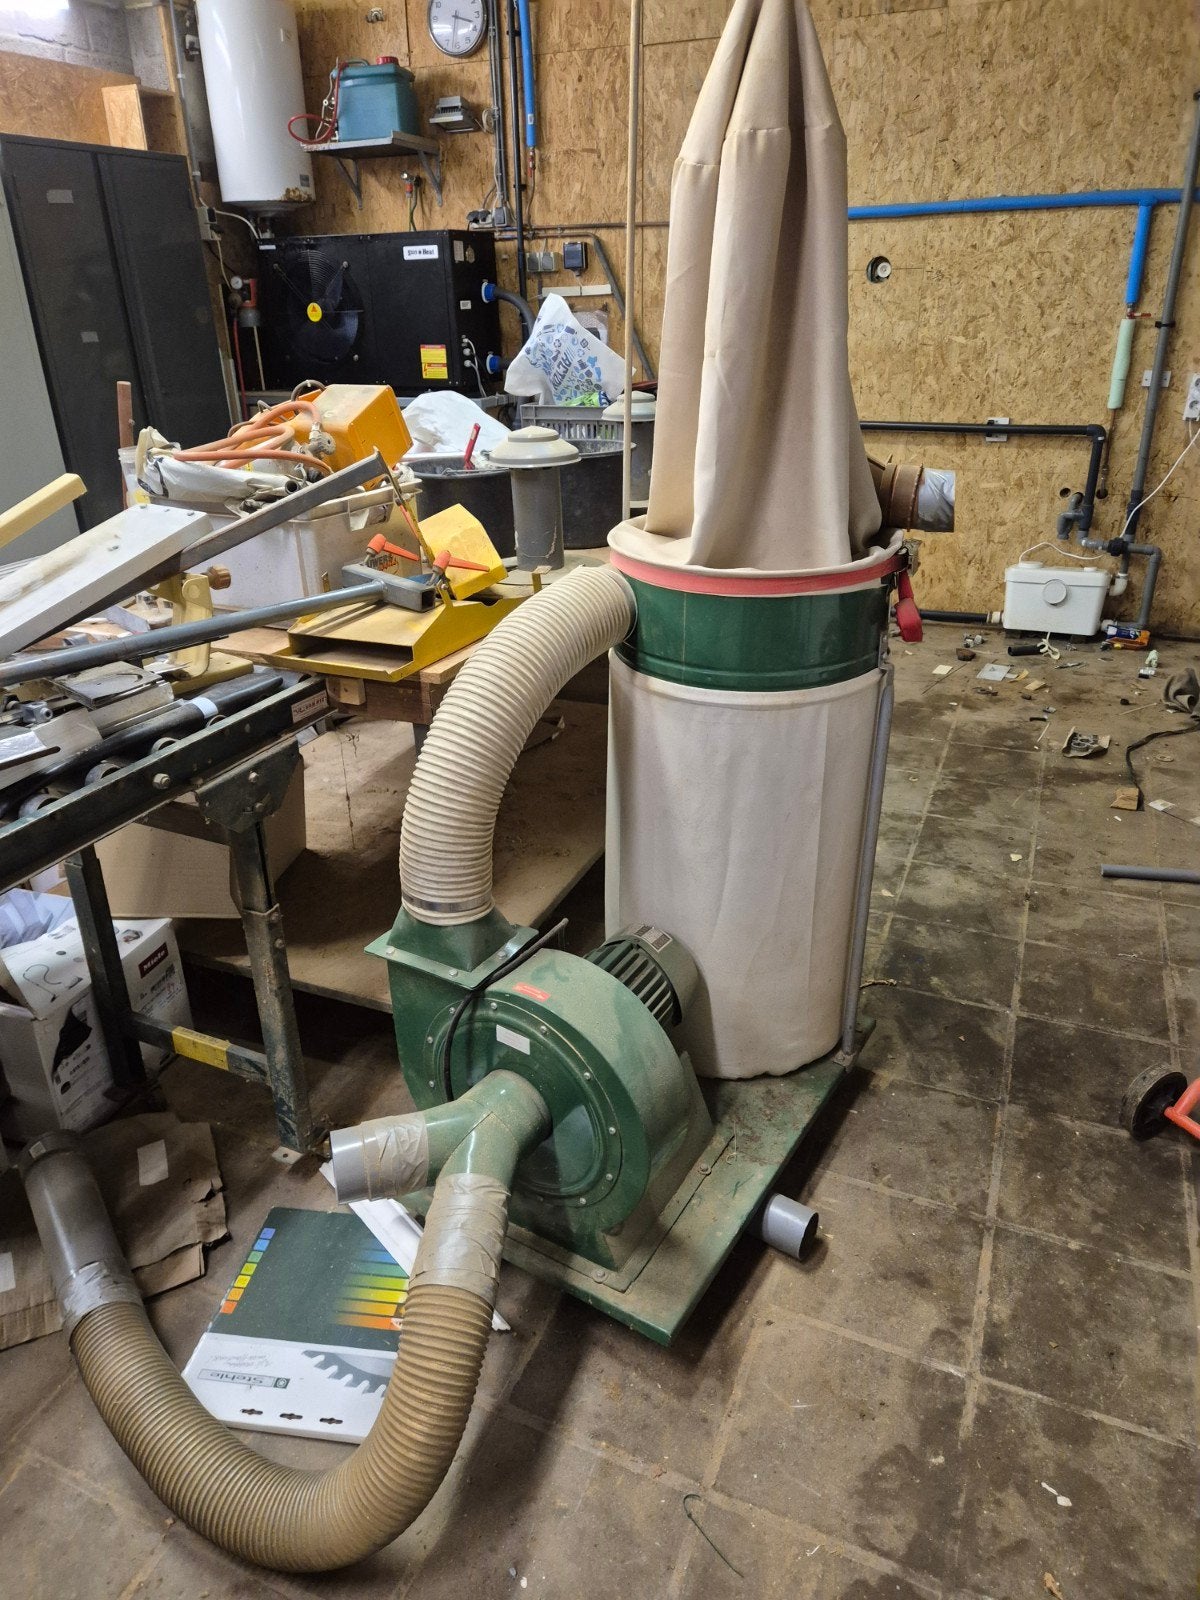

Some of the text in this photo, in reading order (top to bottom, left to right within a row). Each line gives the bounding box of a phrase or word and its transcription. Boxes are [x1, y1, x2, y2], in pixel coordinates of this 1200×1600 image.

[473, 10, 480, 19] 3
[472, 24, 478, 32] 4
[445, 38, 450, 46] 7
[465, 36, 471, 44] 5
[455, 41, 461, 49] 6
[143, 950, 165, 971] Miele
[210, 1372, 263, 1384] Stehle
